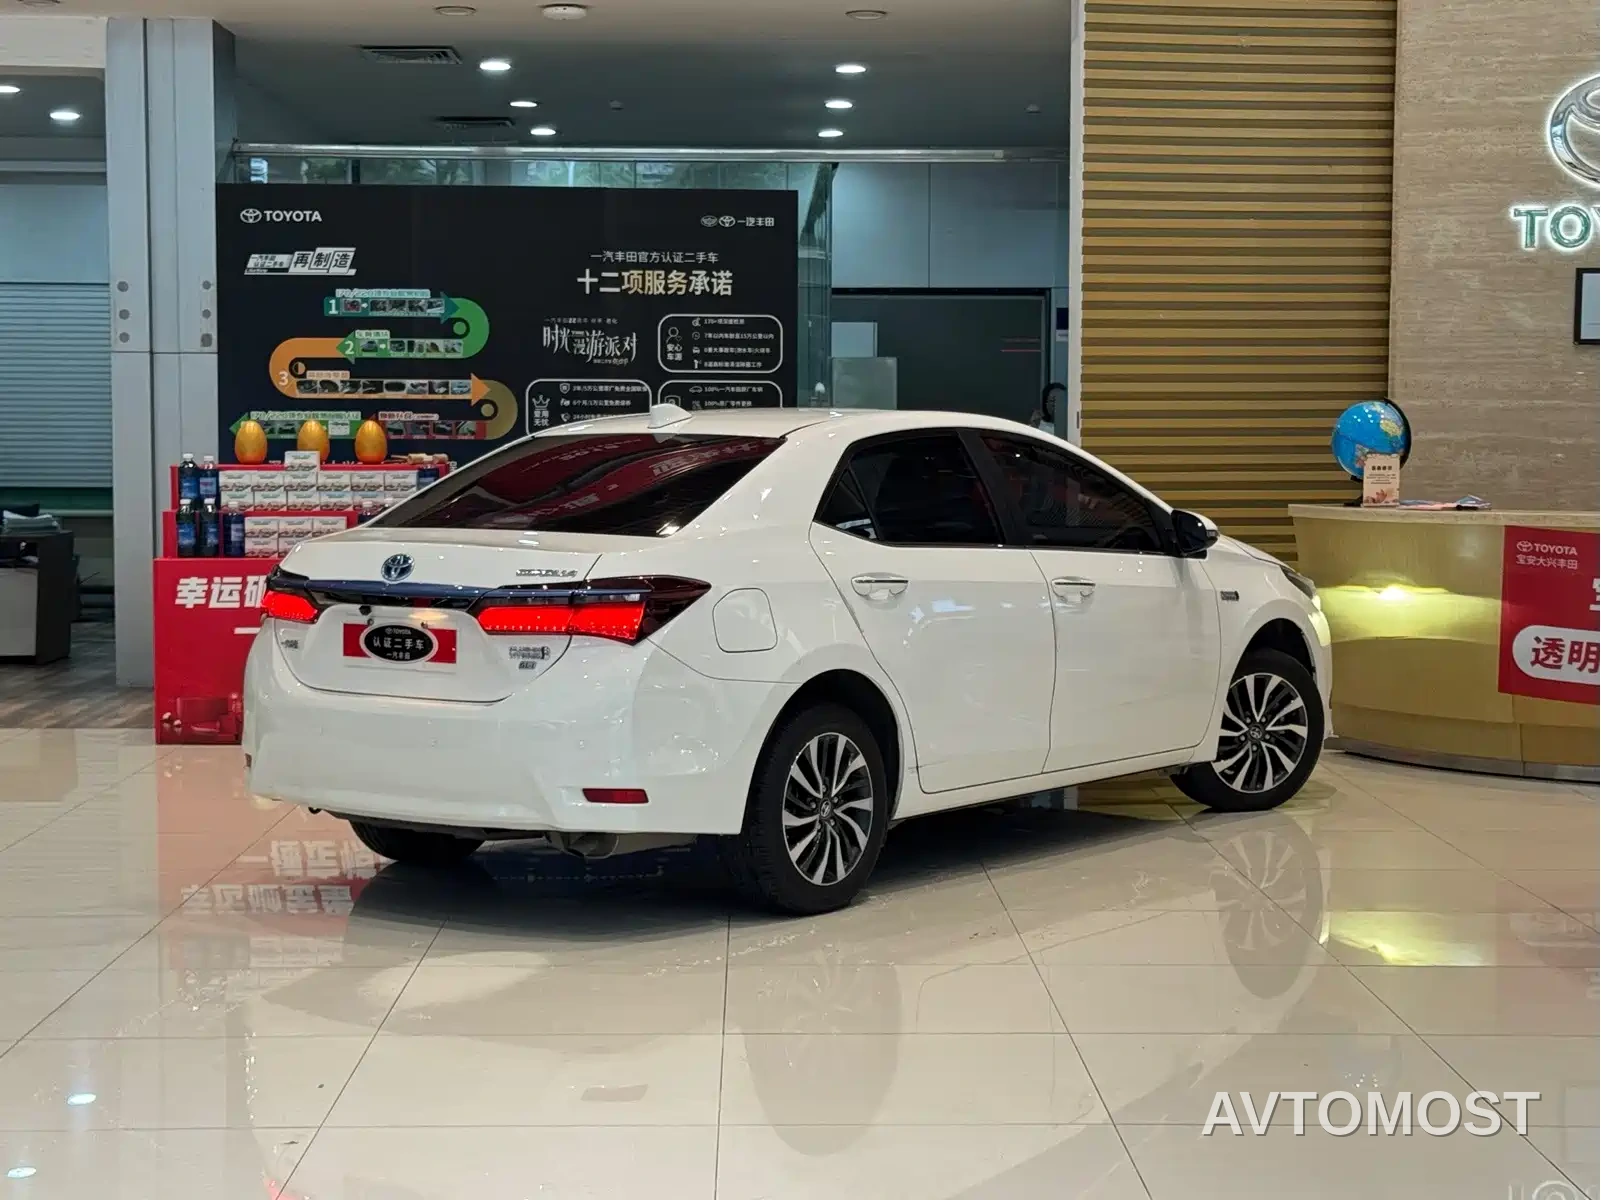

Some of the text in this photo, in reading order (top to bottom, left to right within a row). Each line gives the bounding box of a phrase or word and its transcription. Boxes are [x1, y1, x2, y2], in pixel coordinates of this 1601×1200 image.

[264, 210, 322, 223] TOYOTA
[737, 216, 774, 227] 一汽丰田
[1513, 207, 1600, 249] TO
[293, 251, 351, 269] 再制造
[590, 250, 719, 264] 一汽丰田官方认证二手车
[577, 268, 733, 296] 十二项服务承诺
[329, 299, 338, 314] 1
[345, 341, 354, 355] 2
[666, 344, 683, 352] 安心
[279, 371, 289, 386] 3
[1534, 543, 1578, 555] TOYOTA
[1516, 554, 1578, 570] 宝安大兴丰田
[373, 636, 425, 650] 认证二手车
[1530, 636, 1600, 674] 透明
